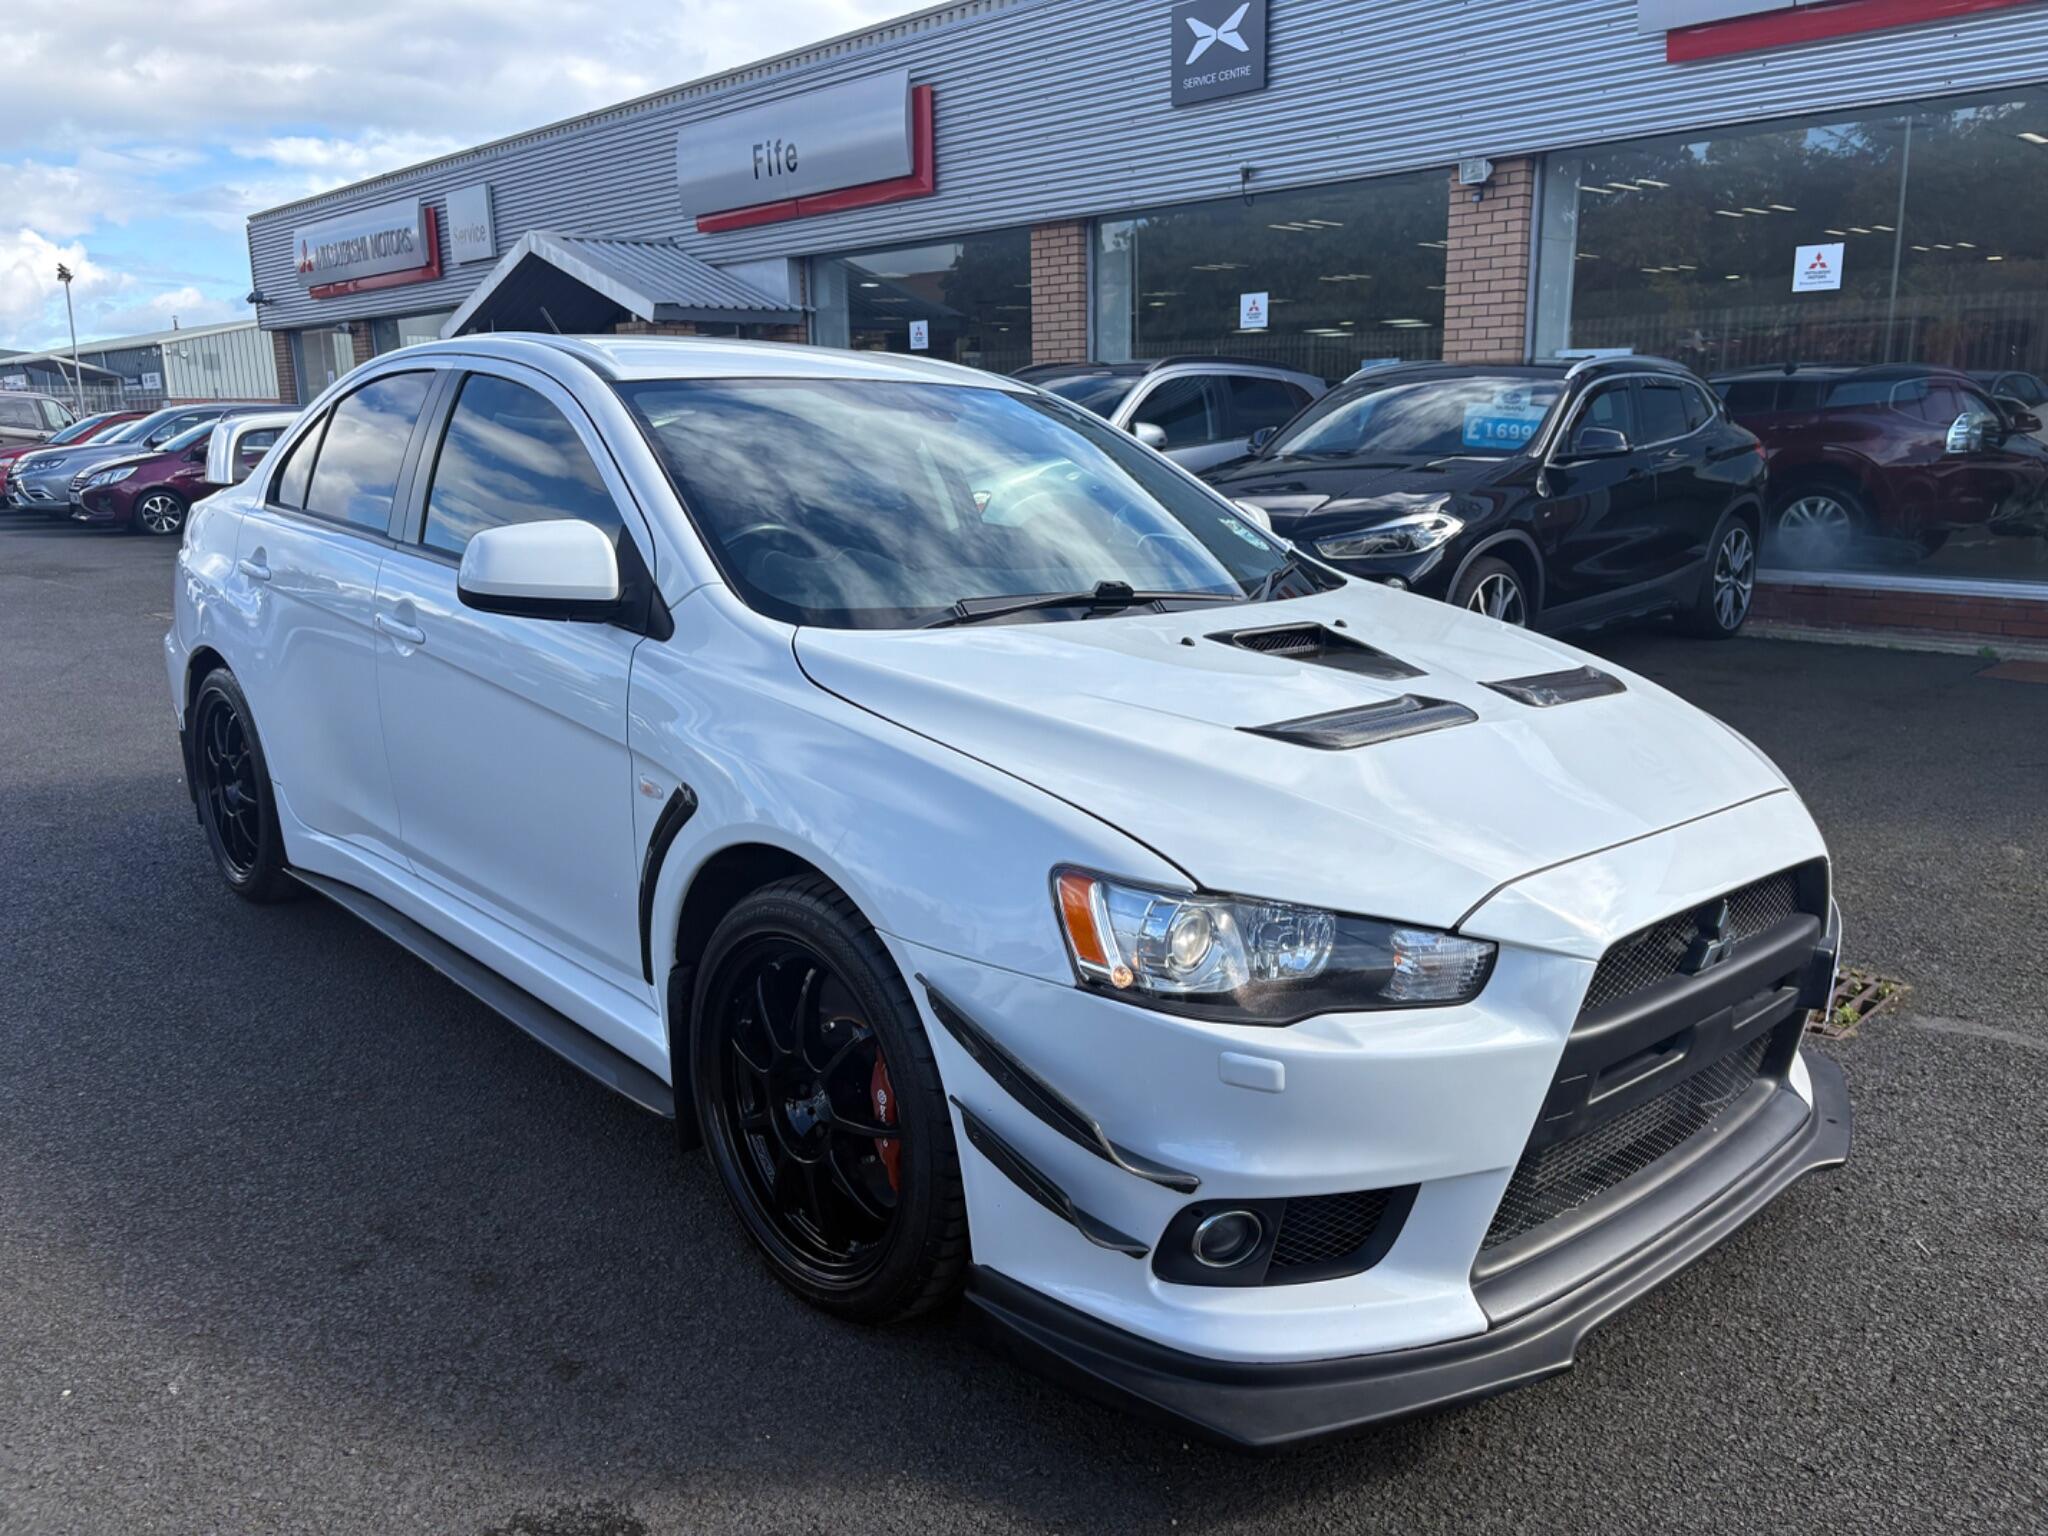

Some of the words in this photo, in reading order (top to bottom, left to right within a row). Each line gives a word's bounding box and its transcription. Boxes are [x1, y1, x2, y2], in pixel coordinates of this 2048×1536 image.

[1183, 73, 1217, 89] SERVICE
[1218, 65, 1252, 81] CENTRE
[753, 138, 798, 180] Fife
[370, 227, 414, 260] MOTORS
[1466, 418, 1536, 441] £1699
